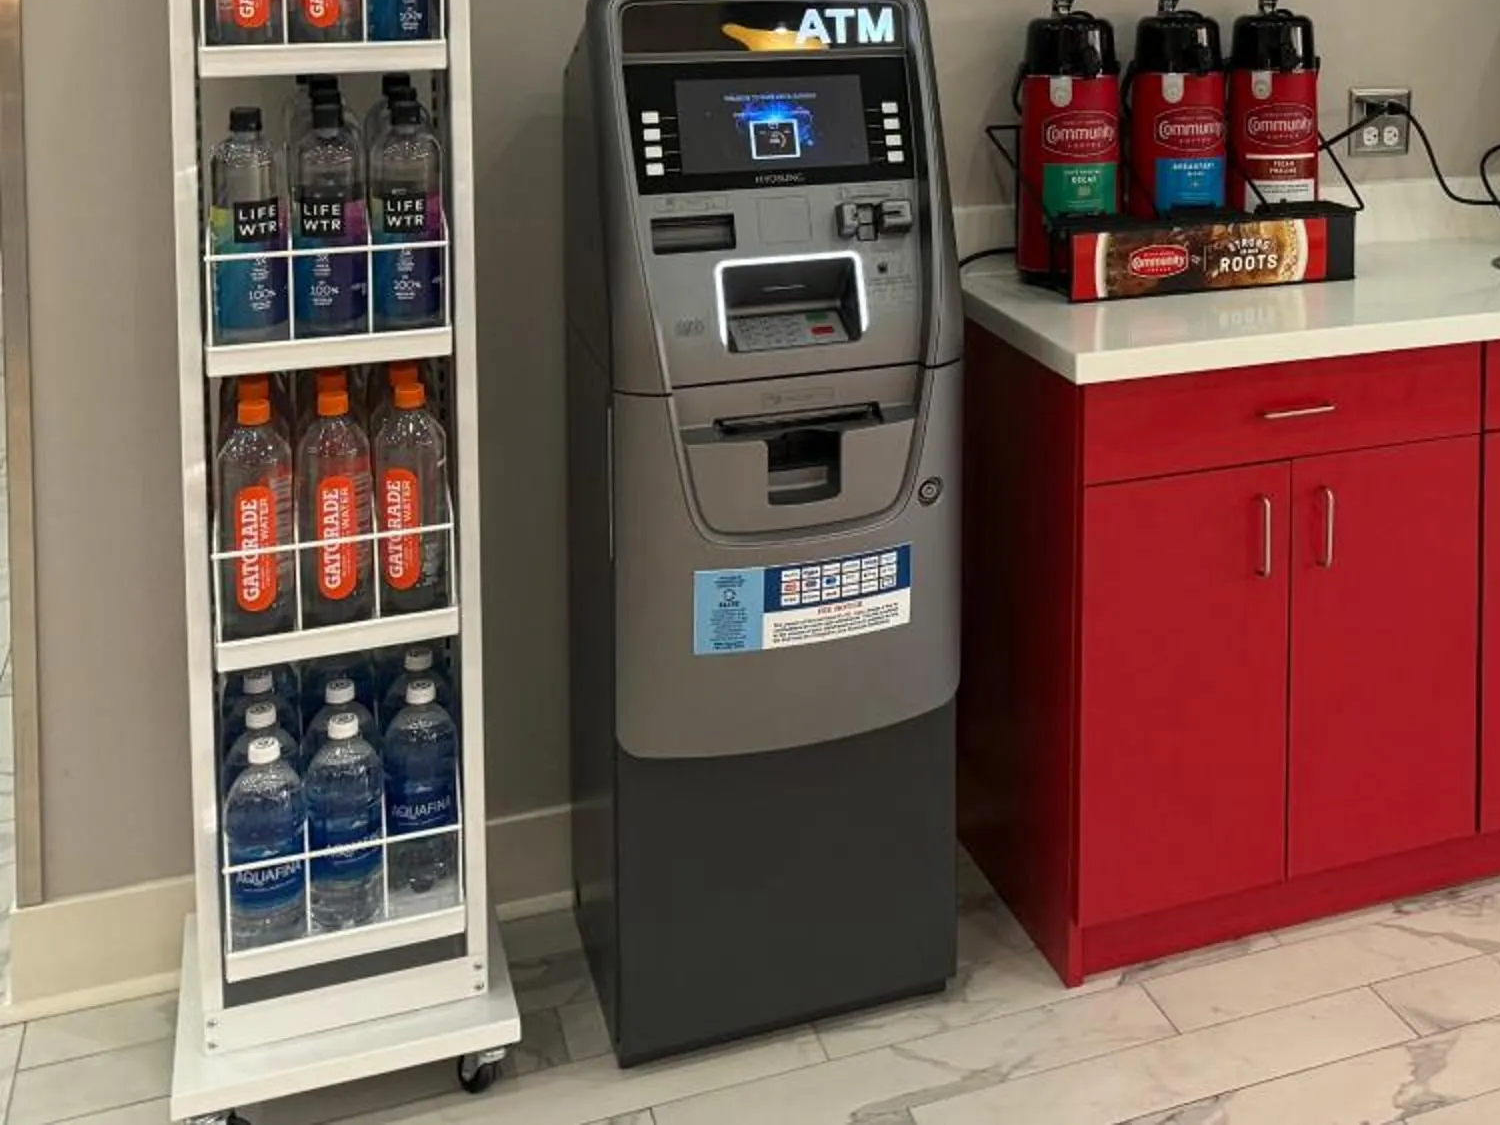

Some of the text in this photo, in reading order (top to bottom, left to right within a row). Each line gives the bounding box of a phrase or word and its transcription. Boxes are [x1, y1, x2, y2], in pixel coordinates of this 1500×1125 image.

[795, 7, 896, 45] ATM
[1046, 124, 1114, 145] Community
[1159, 120, 1222, 140] Community
[1248, 116, 1312, 135] Community
[239, 204, 277, 220] LIFE
[303, 203, 341, 216] LIFE
[386, 198, 424, 212] LIFE
[239, 221, 277, 236] WTR
[303, 218, 341, 231] WTR
[386, 214, 424, 227] WTR
[1219, 254, 1278, 273] ROOTS
[259, 498, 269, 540] WATER
[386, 479, 404, 578] GATORADE
[322, 487, 341, 588] GATORADE
[241, 498, 261, 601] GATORADE
